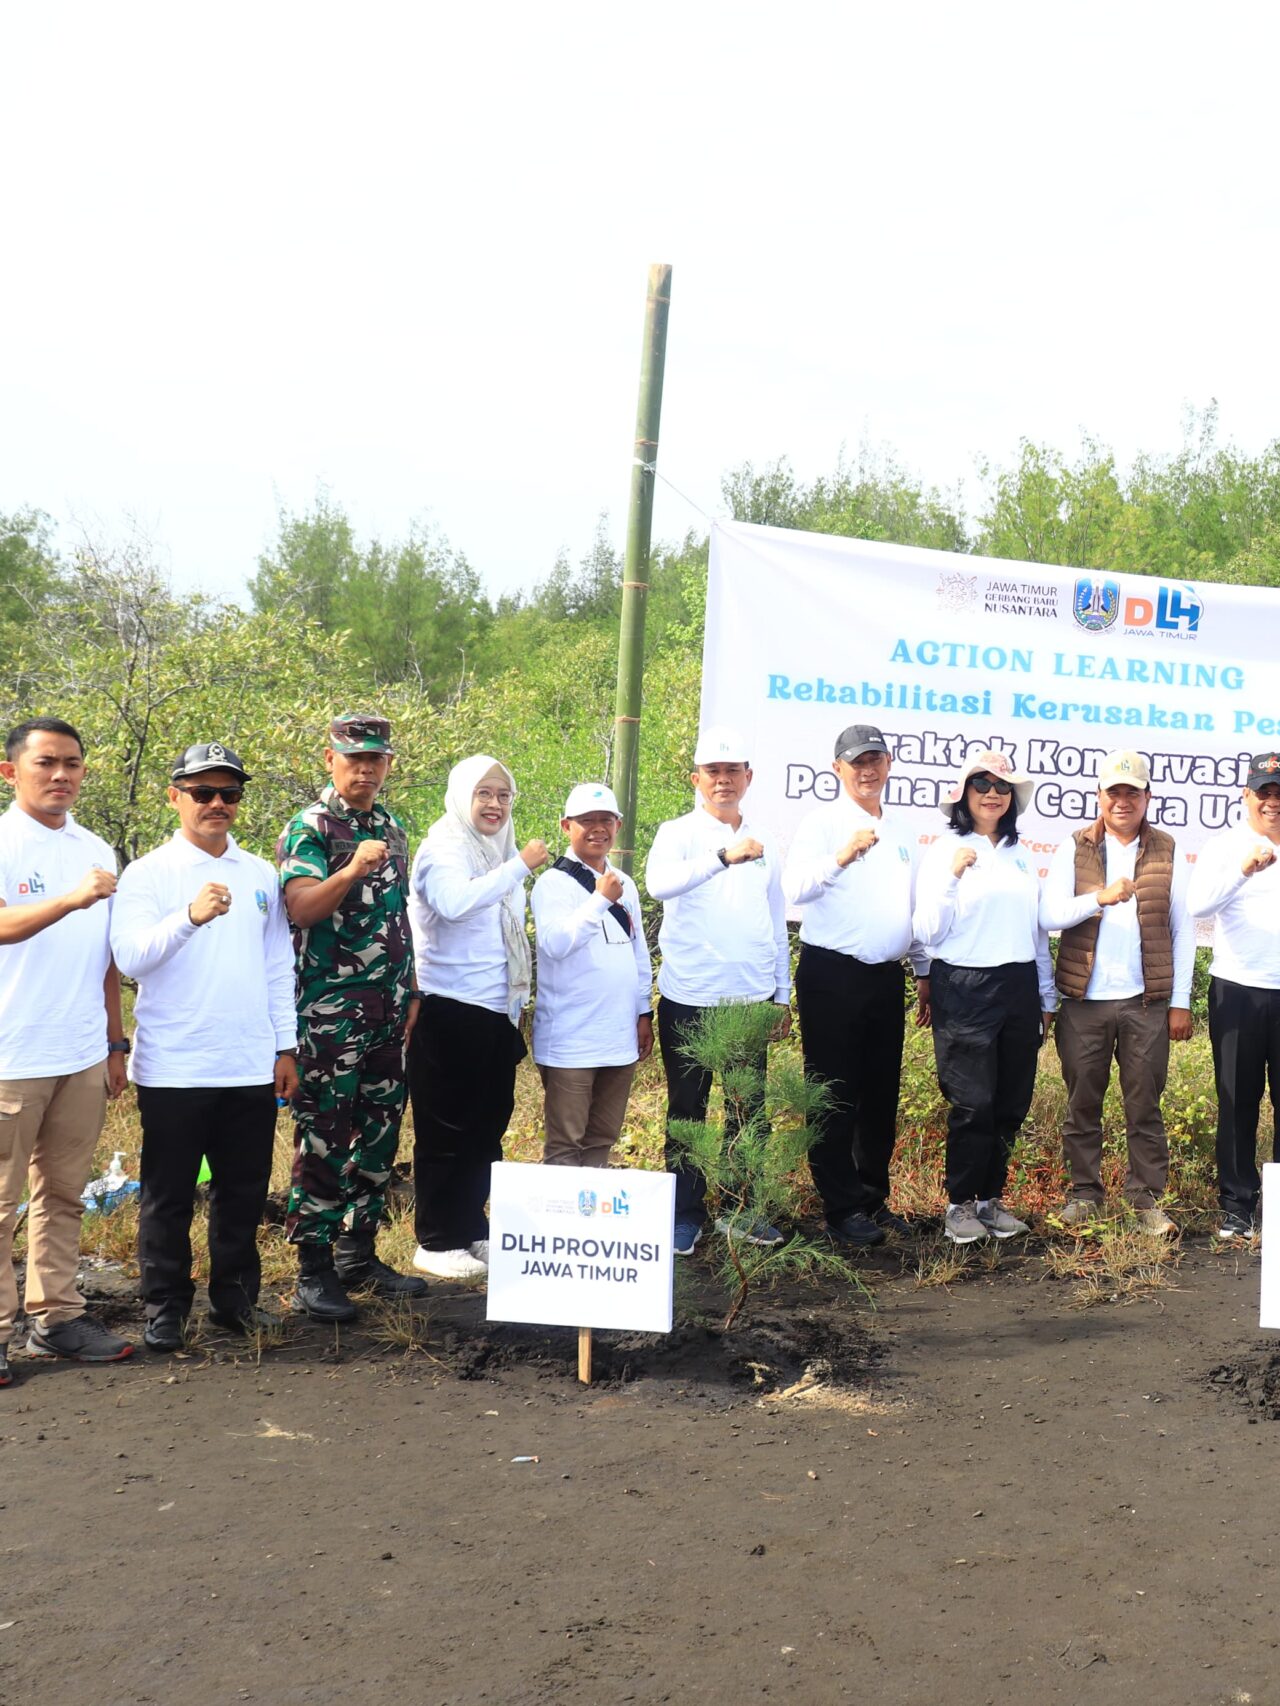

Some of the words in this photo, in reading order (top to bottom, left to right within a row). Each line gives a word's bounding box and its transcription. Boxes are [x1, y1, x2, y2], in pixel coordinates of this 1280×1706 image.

[986, 581, 1018, 594] JAWA
[1021, 584, 1058, 596] TIMUR
[985, 593, 1031, 606] GERBANG
[1033, 596, 1059, 607] BARU
[984, 604, 1058, 618] NUSANTARA
[1123, 628, 1155, 637] JAWA
[1159, 631, 1198, 641] TIMUR
[889, 638, 1033, 673] ACTION
[1053, 652, 1245, 690] LEARNING
[767, 674, 992, 715] Rehabilitasi
[1012, 692, 1215, 732] Kerusakan
[502, 1233, 546, 1254] DLH
[553, 1237, 660, 1262] PROVINSI
[521, 1260, 573, 1279] JAWA
[577, 1264, 638, 1284] TIMUR
